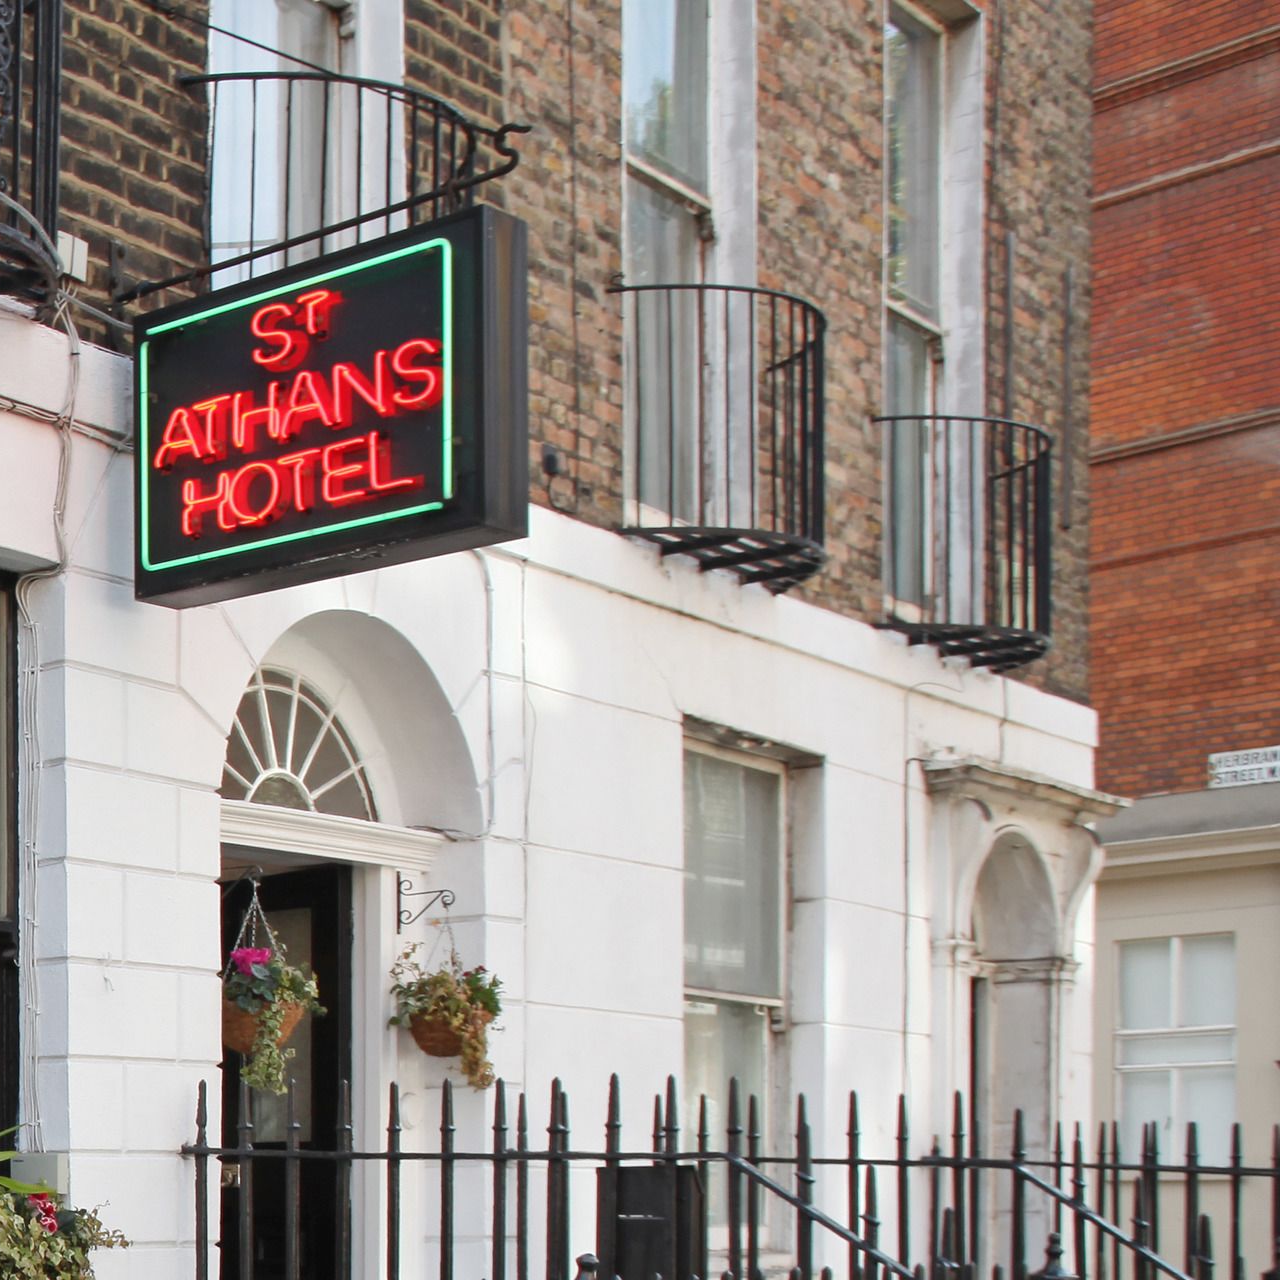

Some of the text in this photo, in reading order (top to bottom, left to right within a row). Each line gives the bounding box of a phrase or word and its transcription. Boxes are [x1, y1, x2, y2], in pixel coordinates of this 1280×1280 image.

[154, 338, 443, 470] ATHANS
[181, 431, 423, 537] HOTEL
[1215, 750, 1280, 769] HERBRAN
[1215, 768, 1263, 785] STREET
